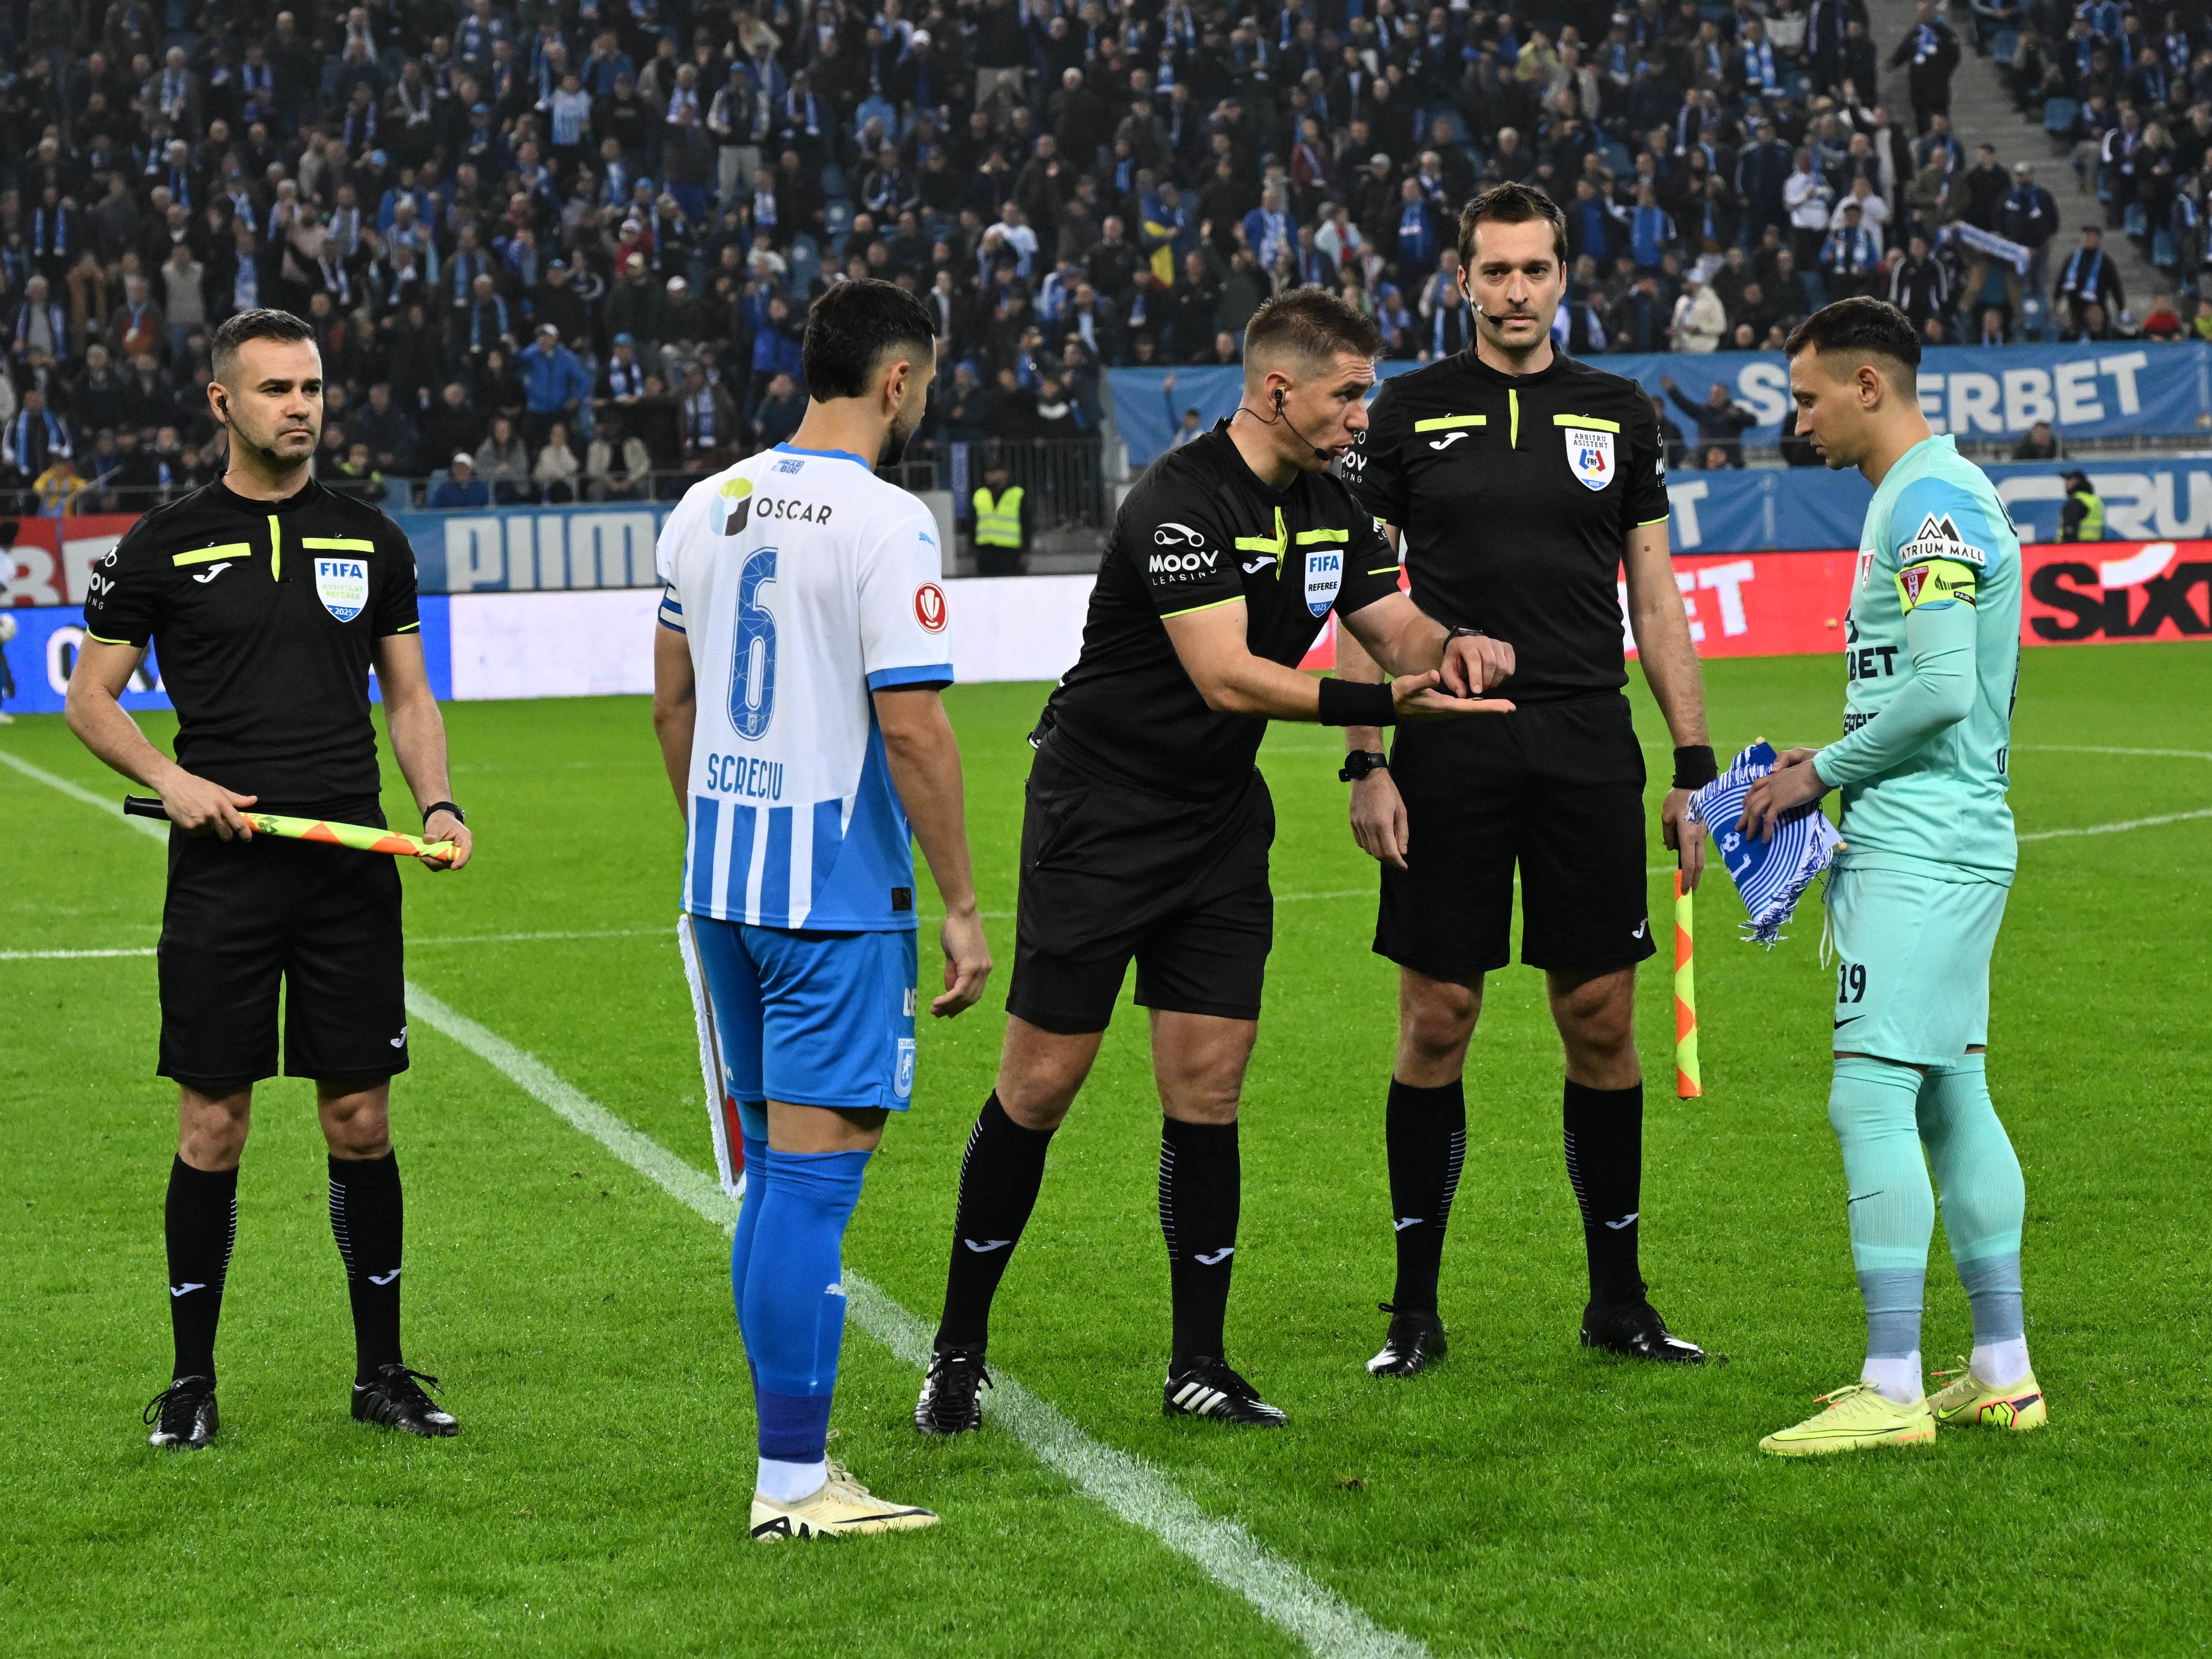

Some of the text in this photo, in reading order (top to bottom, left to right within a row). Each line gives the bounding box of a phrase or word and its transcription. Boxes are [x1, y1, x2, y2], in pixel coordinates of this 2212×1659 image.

[1736, 351, 2148, 435] SERBET
[1573, 440, 1608, 449] ASISTENT
[1575, 433, 1606, 442] ARBITRU
[756, 497, 833, 525] OSCAR
[445, 511, 674, 592] PUM
[1902, 542, 1983, 561] ATRIUM MALL
[320, 562, 363, 579] FIFA
[1149, 550, 1219, 573] MOOV
[1309, 555, 1339, 573] FIFA
[322, 584, 363, 592] ASSISTANT
[325, 591, 360, 600] REFEREE
[1308, 581, 1338, 592] REFEREE
[334, 607, 353, 616] 2025
[1313, 603, 1327, 612] 2025
[727, 546, 778, 741] 6
[1847, 646, 1899, 681] BET
[707, 753, 783, 801] SCRECIU
[1839, 963, 1867, 1004] 19
